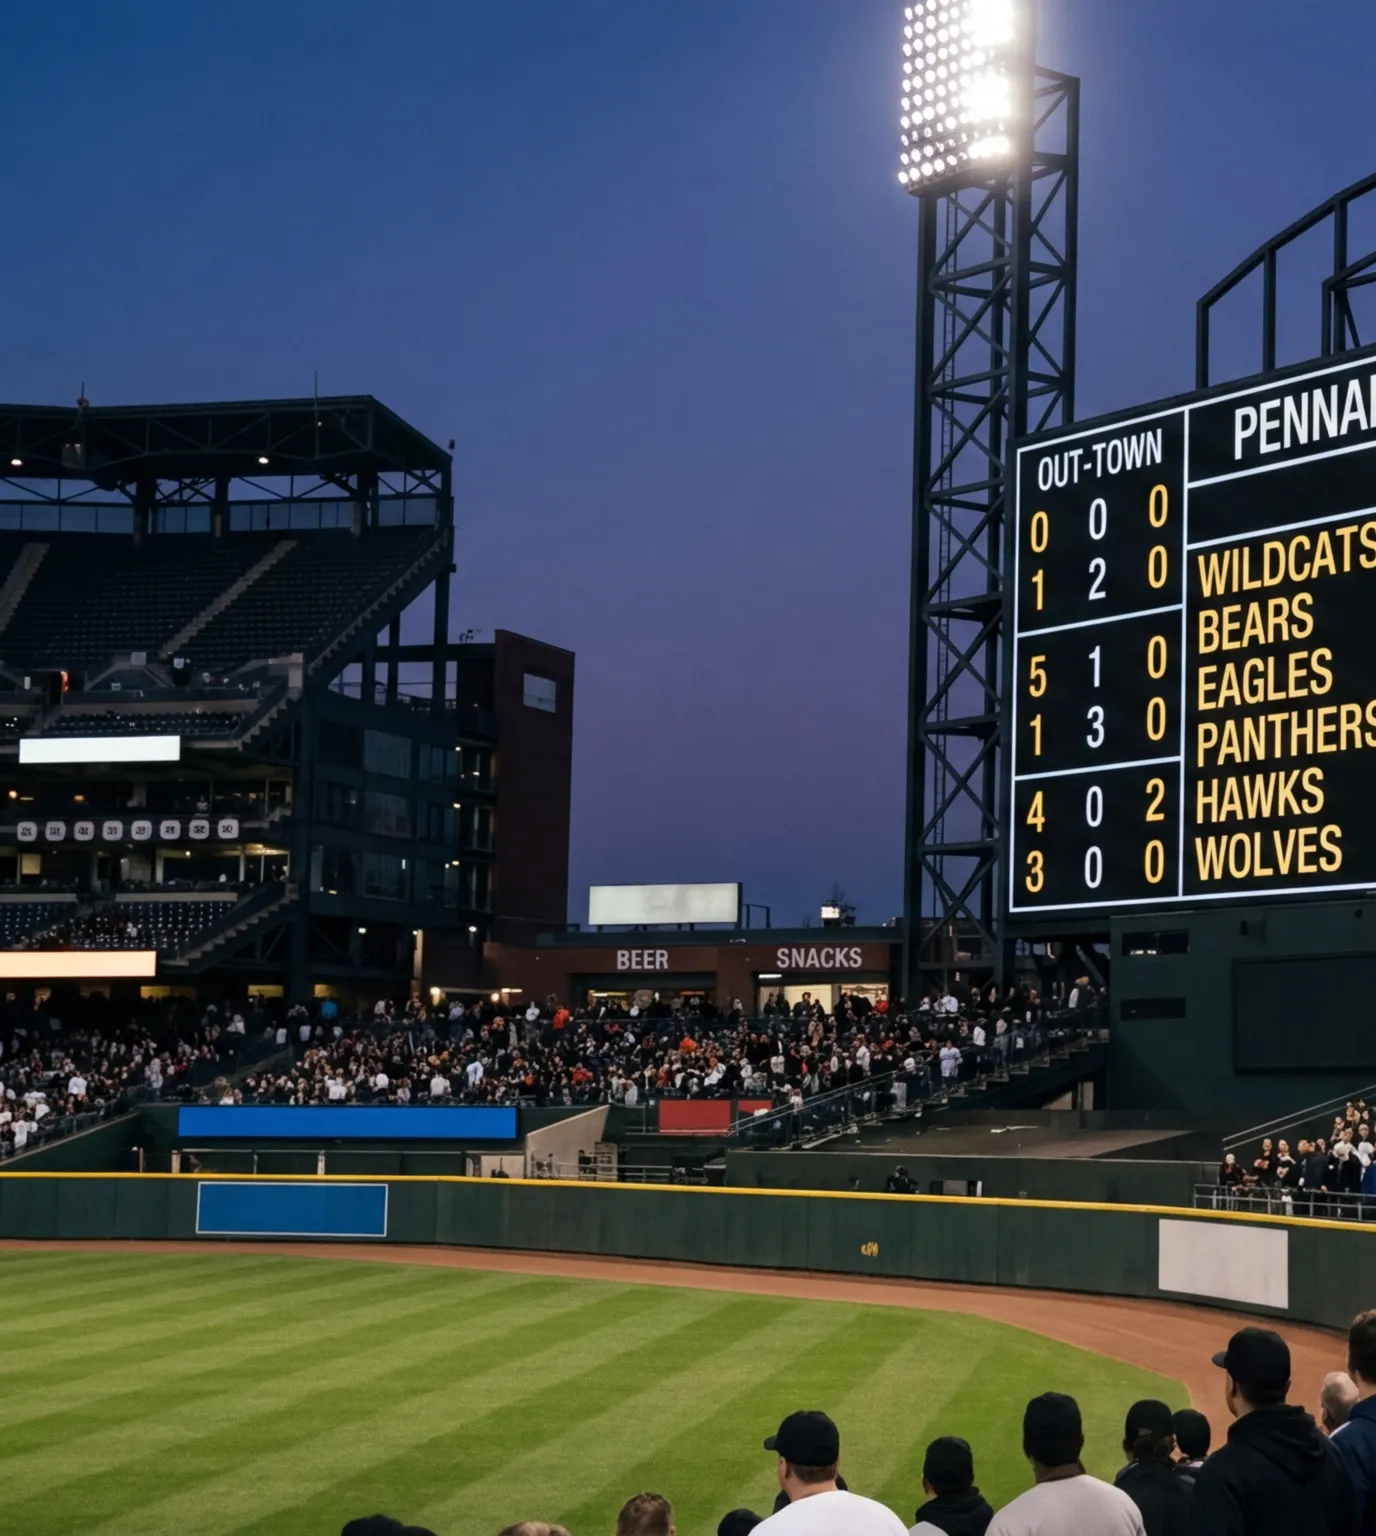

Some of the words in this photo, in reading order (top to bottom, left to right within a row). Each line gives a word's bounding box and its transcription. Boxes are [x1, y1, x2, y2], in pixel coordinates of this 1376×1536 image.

[1038, 428, 1162, 491] OUT-TOWN
[1031, 511, 1048, 552] 0
[1089, 498, 1107, 540] 0
[1149, 485, 1168, 527] 0
[1032, 570, 1043, 610] 1
[1089, 558, 1106, 600] 2
[1149, 545, 1167, 588] 0
[1199, 592, 1313, 654] BEARS
[1030, 655, 1046, 697] 5
[1089, 646, 1100, 687] 1
[1148, 636, 1166, 679] 0
[1198, 648, 1332, 710] EAGLES
[1030, 714, 1041, 755] 1
[1087, 706, 1104, 748] 3
[1147, 697, 1166, 740] 0
[1027, 791, 1045, 832] 4
[1086, 786, 1103, 827] 0
[1146, 778, 1164, 821] 2
[1197, 767, 1324, 824] HAWKS
[1026, 851, 1043, 892] 3
[1085, 846, 1102, 888] 0
[1145, 840, 1164, 883] 0
[1195, 824, 1342, 880] WOLVES
[617, 950, 668, 969] BEER
[777, 947, 862, 968] SNACKS
